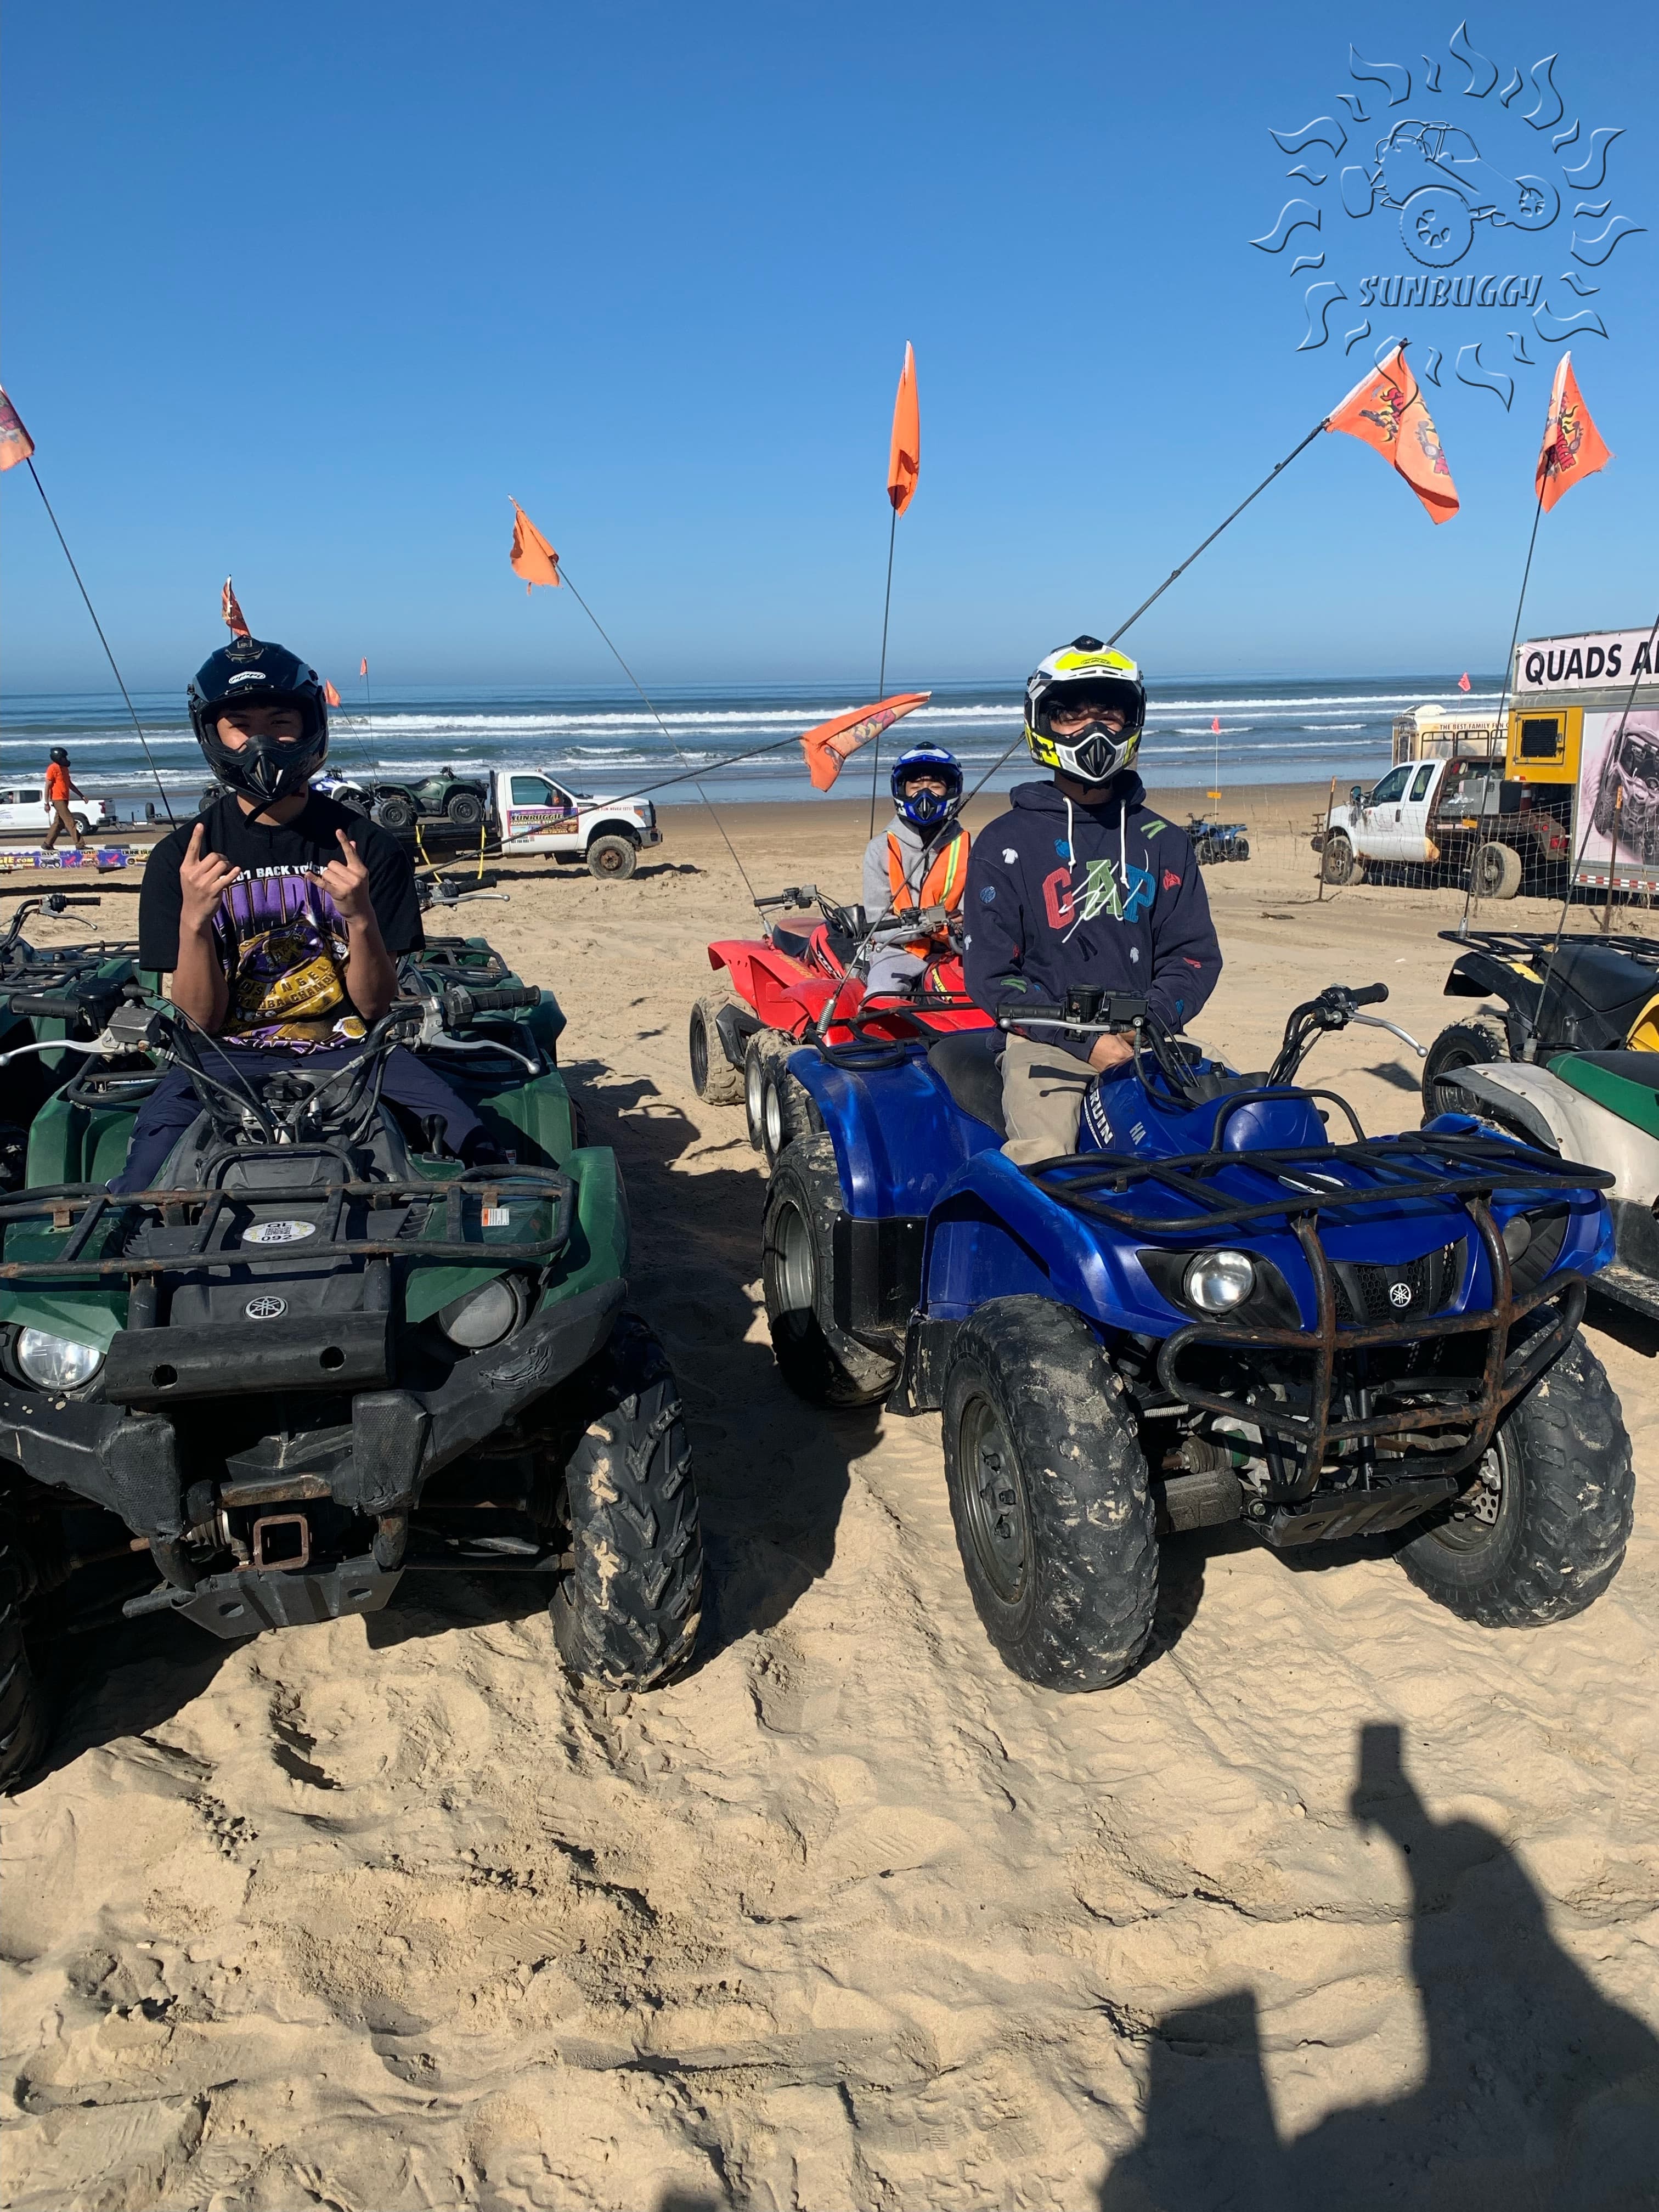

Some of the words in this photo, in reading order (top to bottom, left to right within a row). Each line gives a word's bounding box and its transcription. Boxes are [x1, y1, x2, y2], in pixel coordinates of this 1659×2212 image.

[1526, 644, 1622, 685] QUADS
[1630, 641, 1659, 676] A
[256, 866, 290, 878] BACK
[292, 865, 308, 875] TO
[269, 964, 335, 995] ANGEL
[260, 997, 285, 1009] NBA
